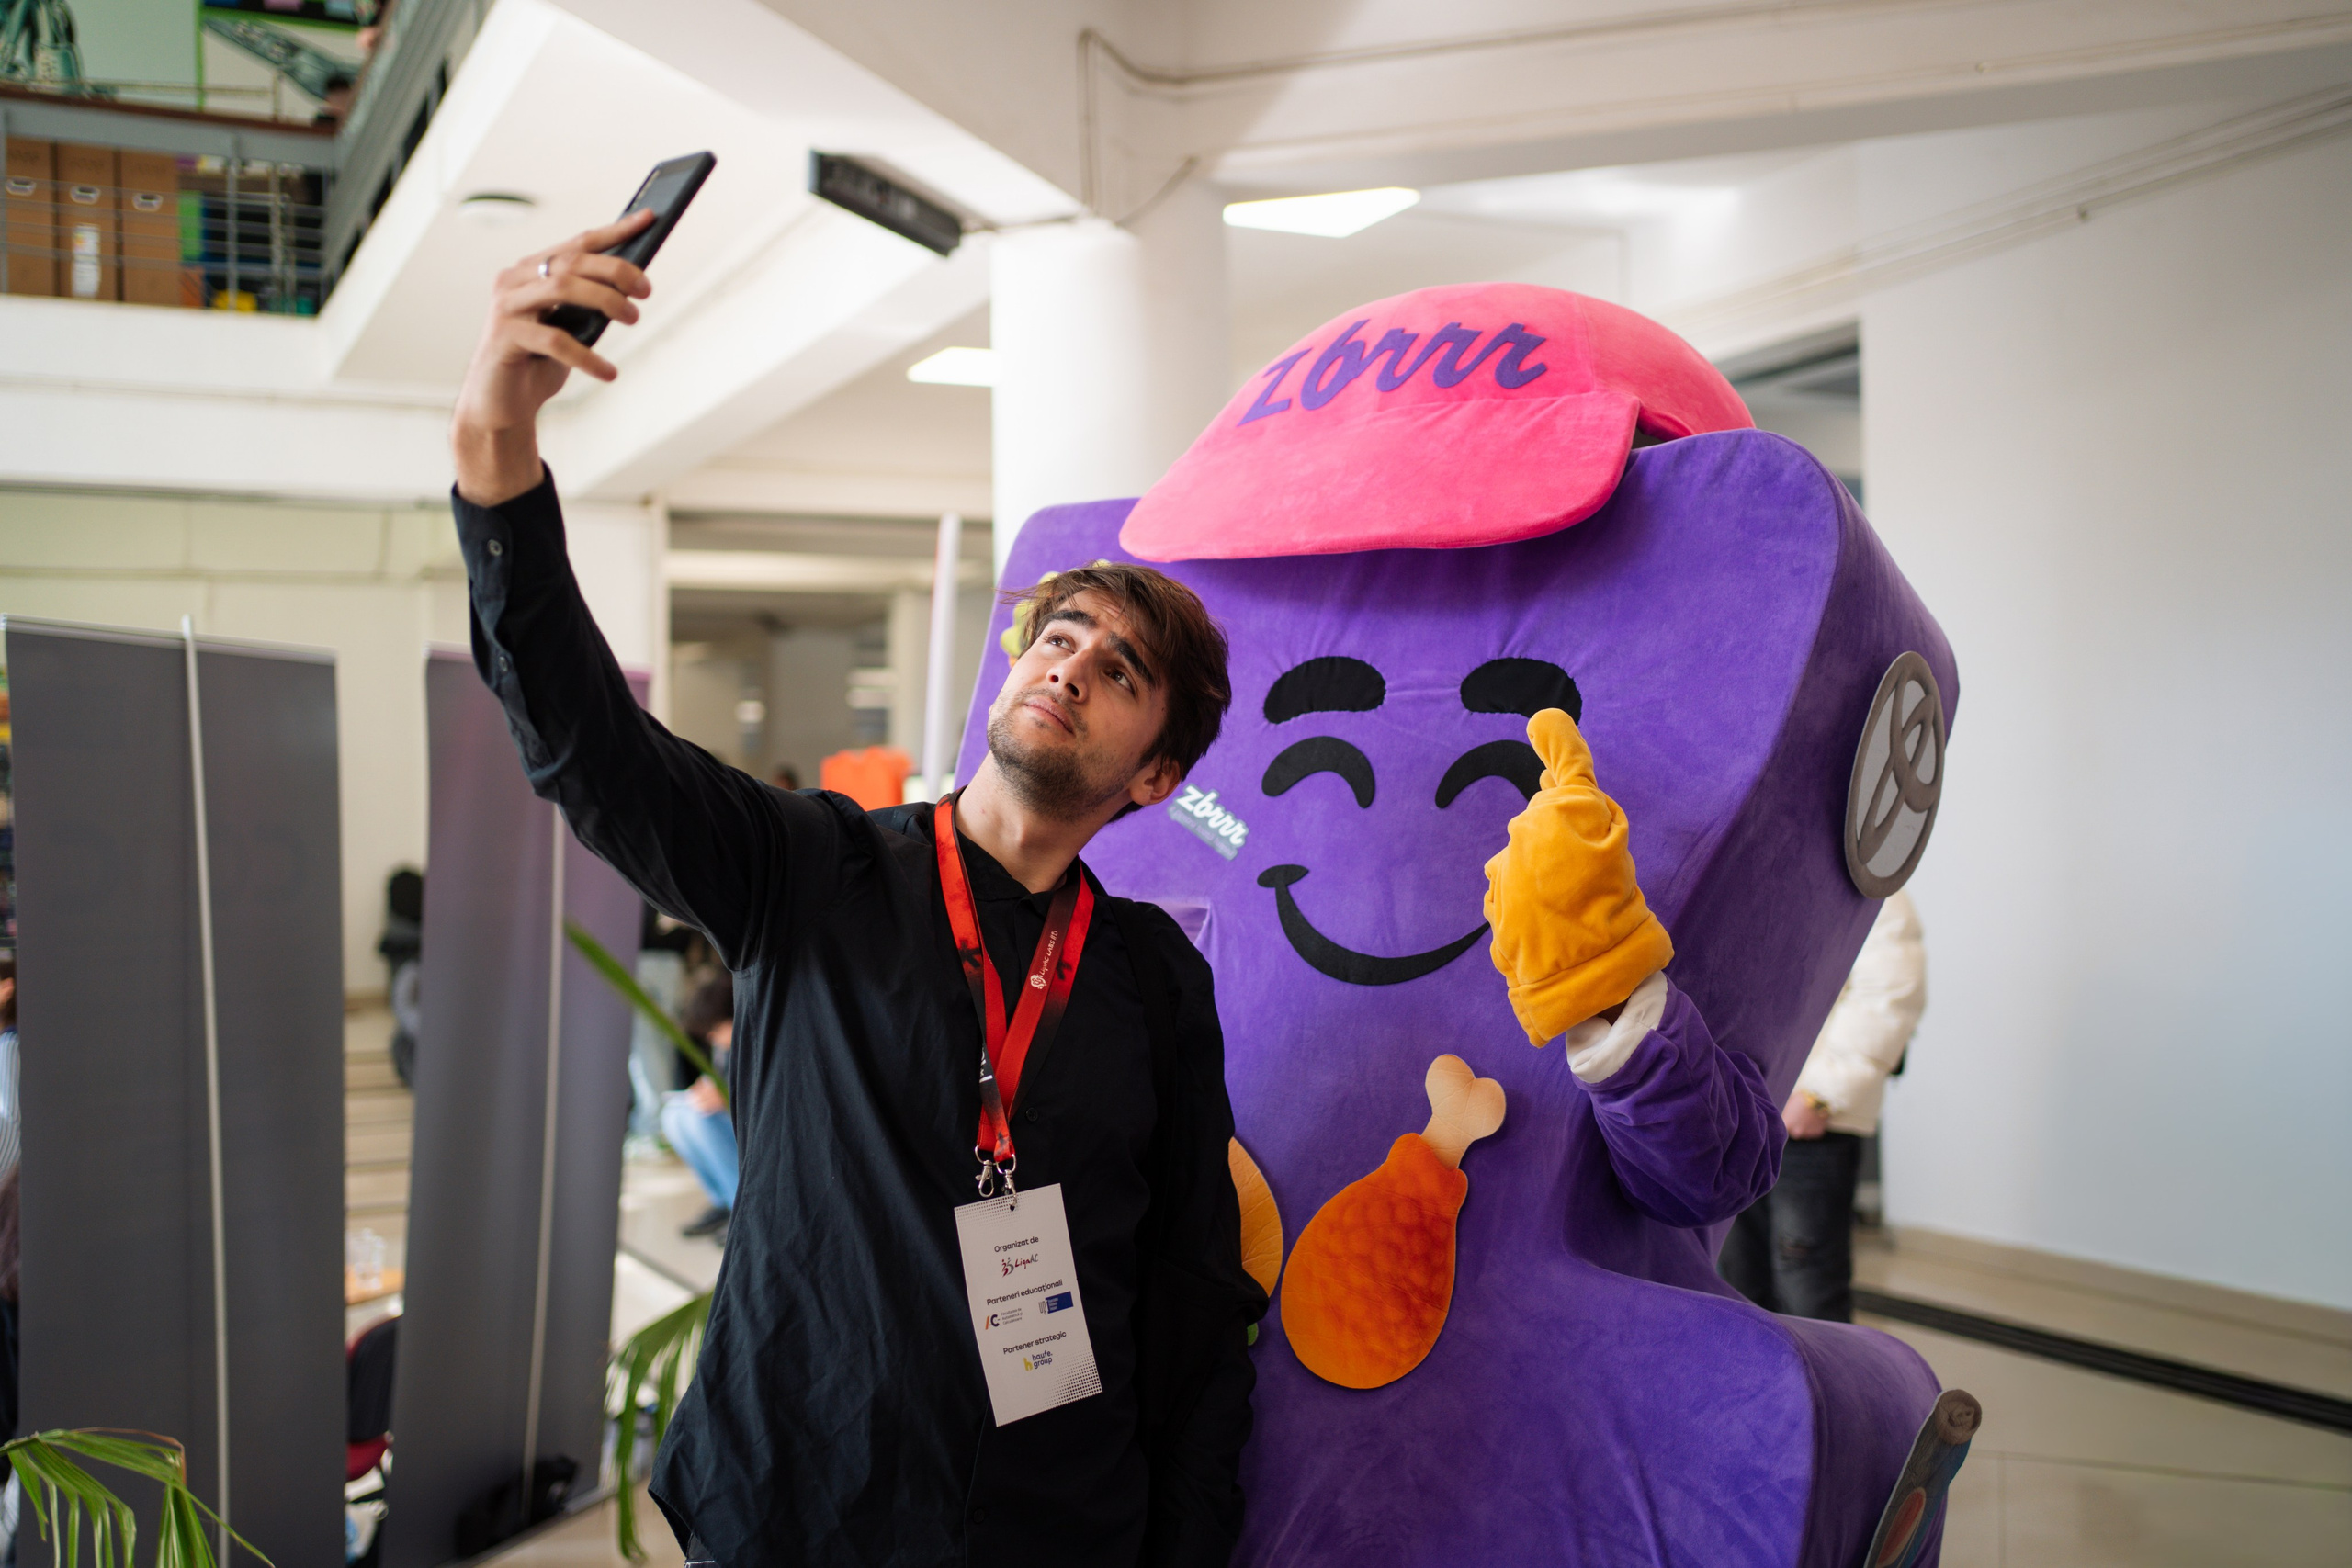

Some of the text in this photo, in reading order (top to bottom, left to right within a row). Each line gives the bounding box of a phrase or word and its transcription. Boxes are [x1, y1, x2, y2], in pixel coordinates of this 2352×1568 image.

[1237, 319, 1548, 427] zbrrr
[1176, 785, 1246, 845] zbrrr
[994, 1238, 1029, 1252] Organizat
[987, 1291, 1020, 1305] Parteneri
[1003, 1331, 1067, 1354] Partener strategic
[1034, 1358, 1053, 1369] group
